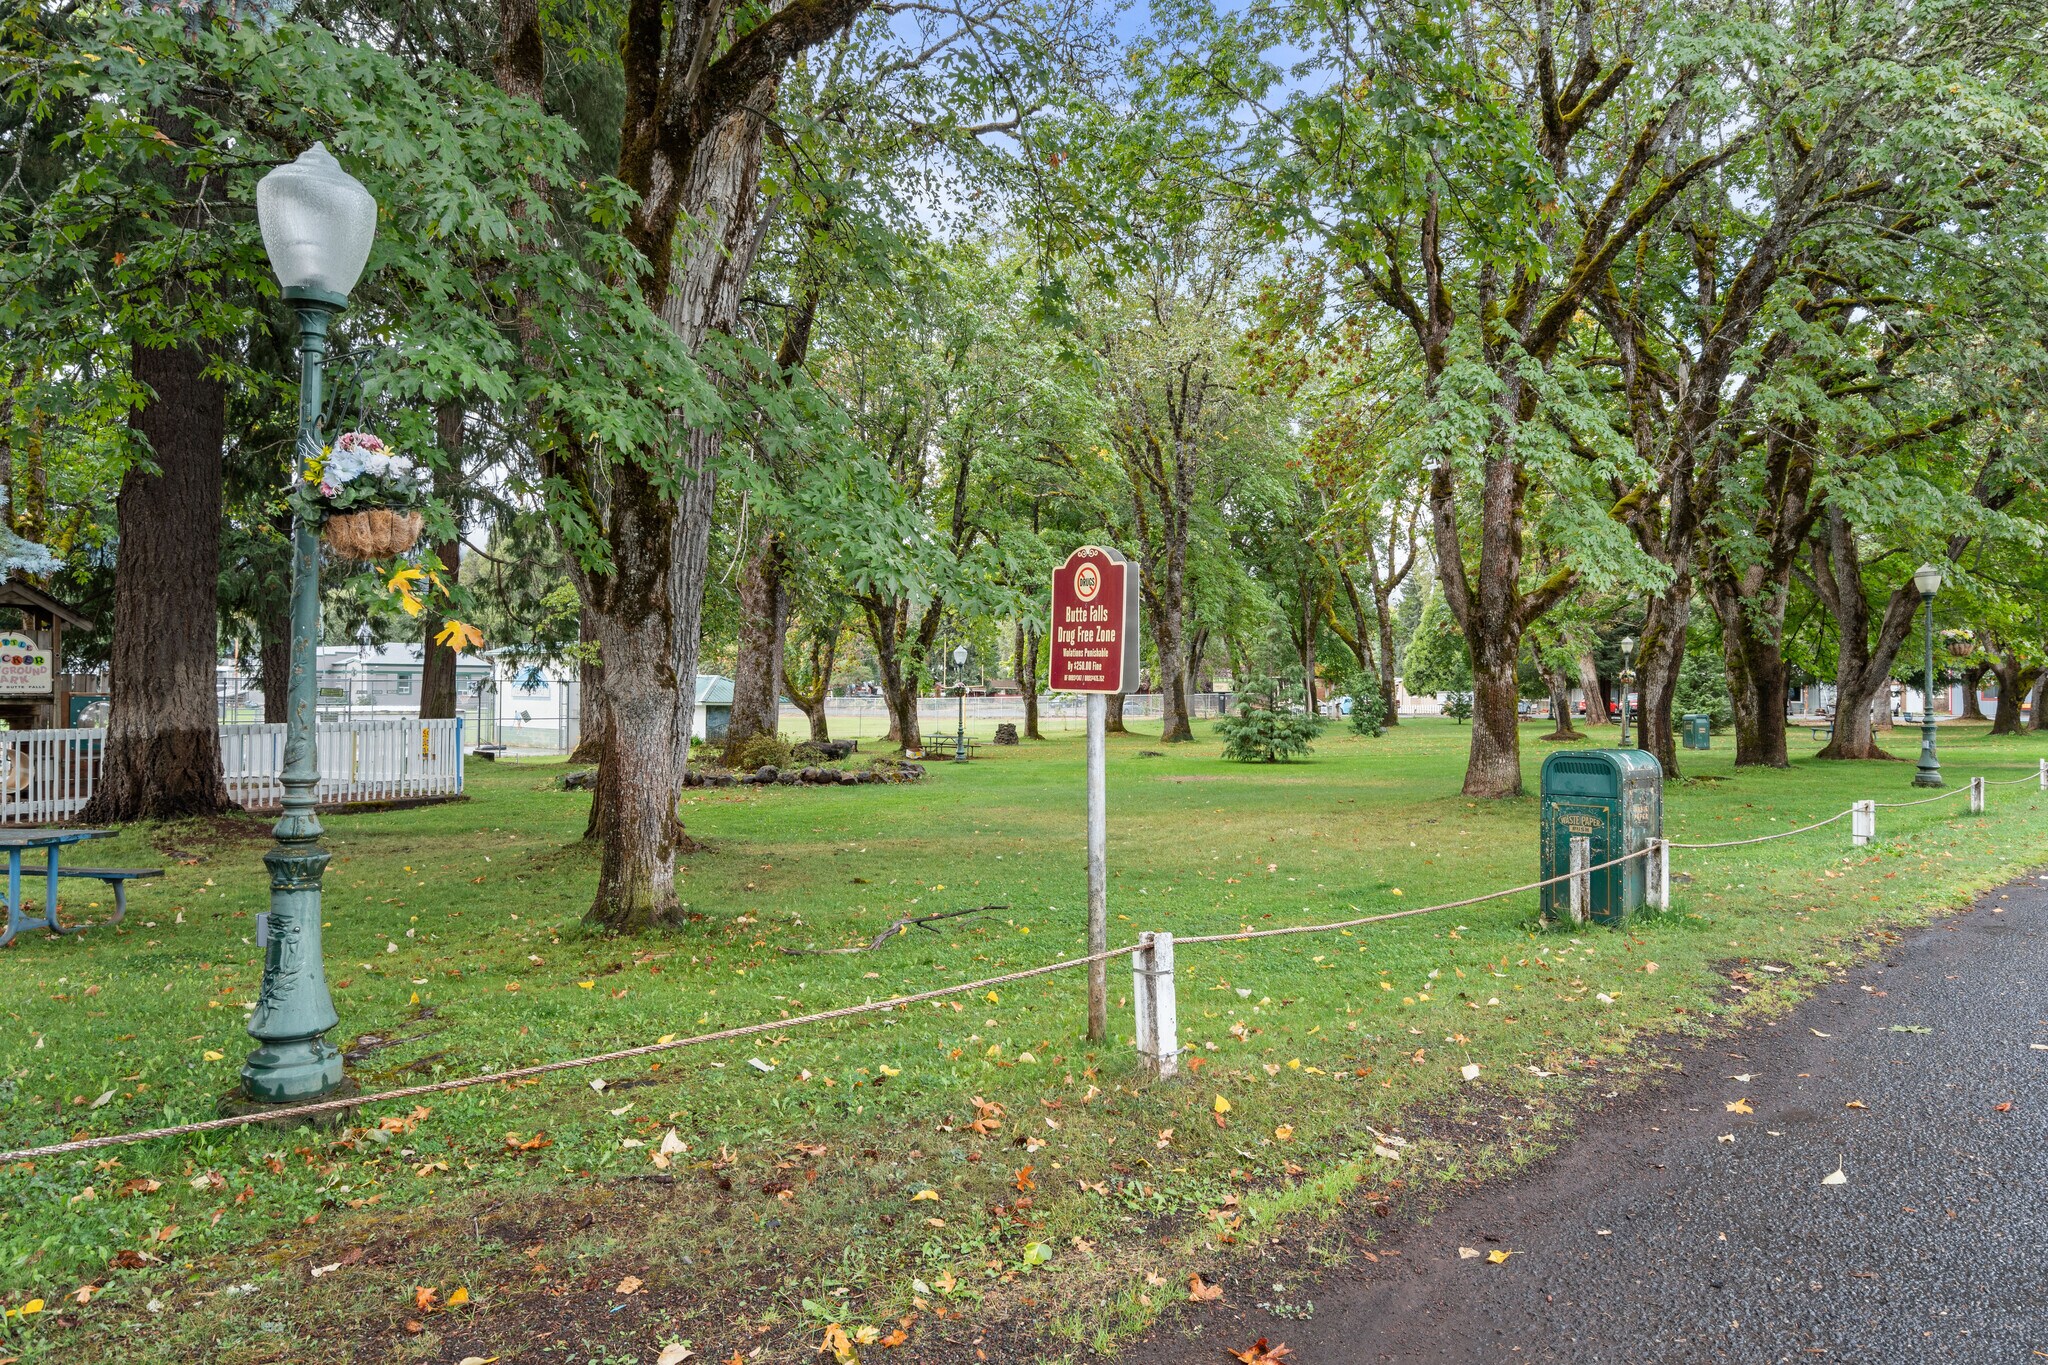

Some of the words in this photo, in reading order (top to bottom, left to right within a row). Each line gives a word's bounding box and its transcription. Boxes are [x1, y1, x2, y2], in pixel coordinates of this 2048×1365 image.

[1080, 577, 1095, 587] DRUGS
[1065, 606, 1088, 622] Butte
[1090, 605, 1108, 621] Falls
[1057, 626, 1076, 646] Drug
[1077, 626, 1094, 642] Free
[1096, 626, 1116, 642] Zone
[0, 639, 33, 651] TTLE
[1062, 648, 1084, 657] Violations
[1084, 648, 1109, 657] Punishable
[0, 654, 44, 665] CKER
[1092, 661, 1102, 670] Fine
[0, 666, 47, 676] GROUND
[0, 675, 29, 684] ARK
[1561, 815, 1580, 825] WASTE
[1581, 816, 1601, 827] PAPER
